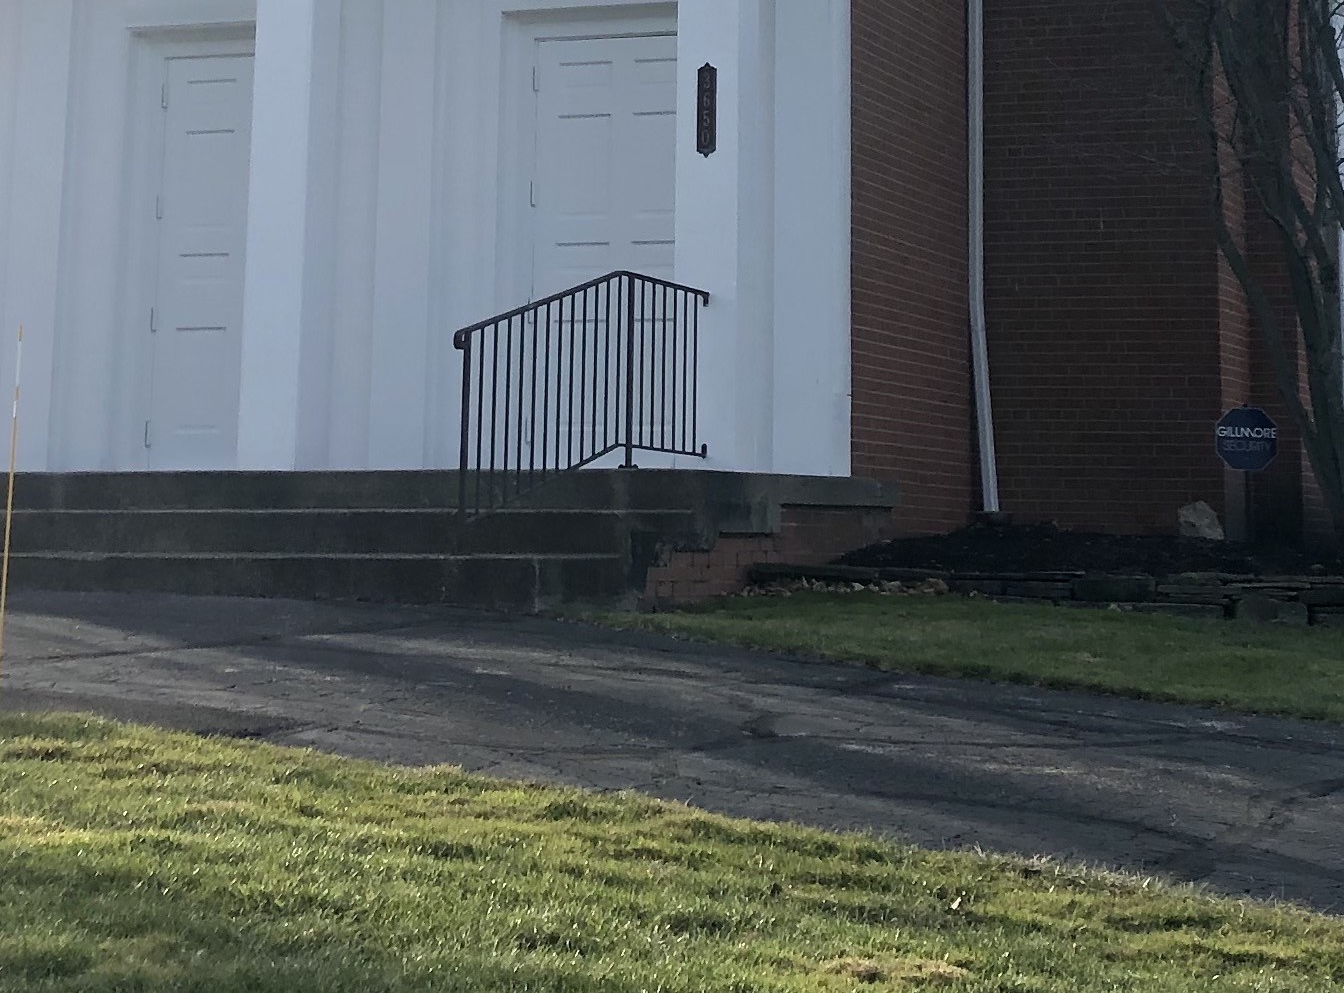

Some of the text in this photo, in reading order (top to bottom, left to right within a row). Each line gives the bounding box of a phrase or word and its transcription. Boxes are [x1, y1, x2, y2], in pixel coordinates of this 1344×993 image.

[701, 71, 711, 145] 3650
[1217, 426, 1278, 439] GILLMORE
[1223, 439, 1272, 452] SECURITY
